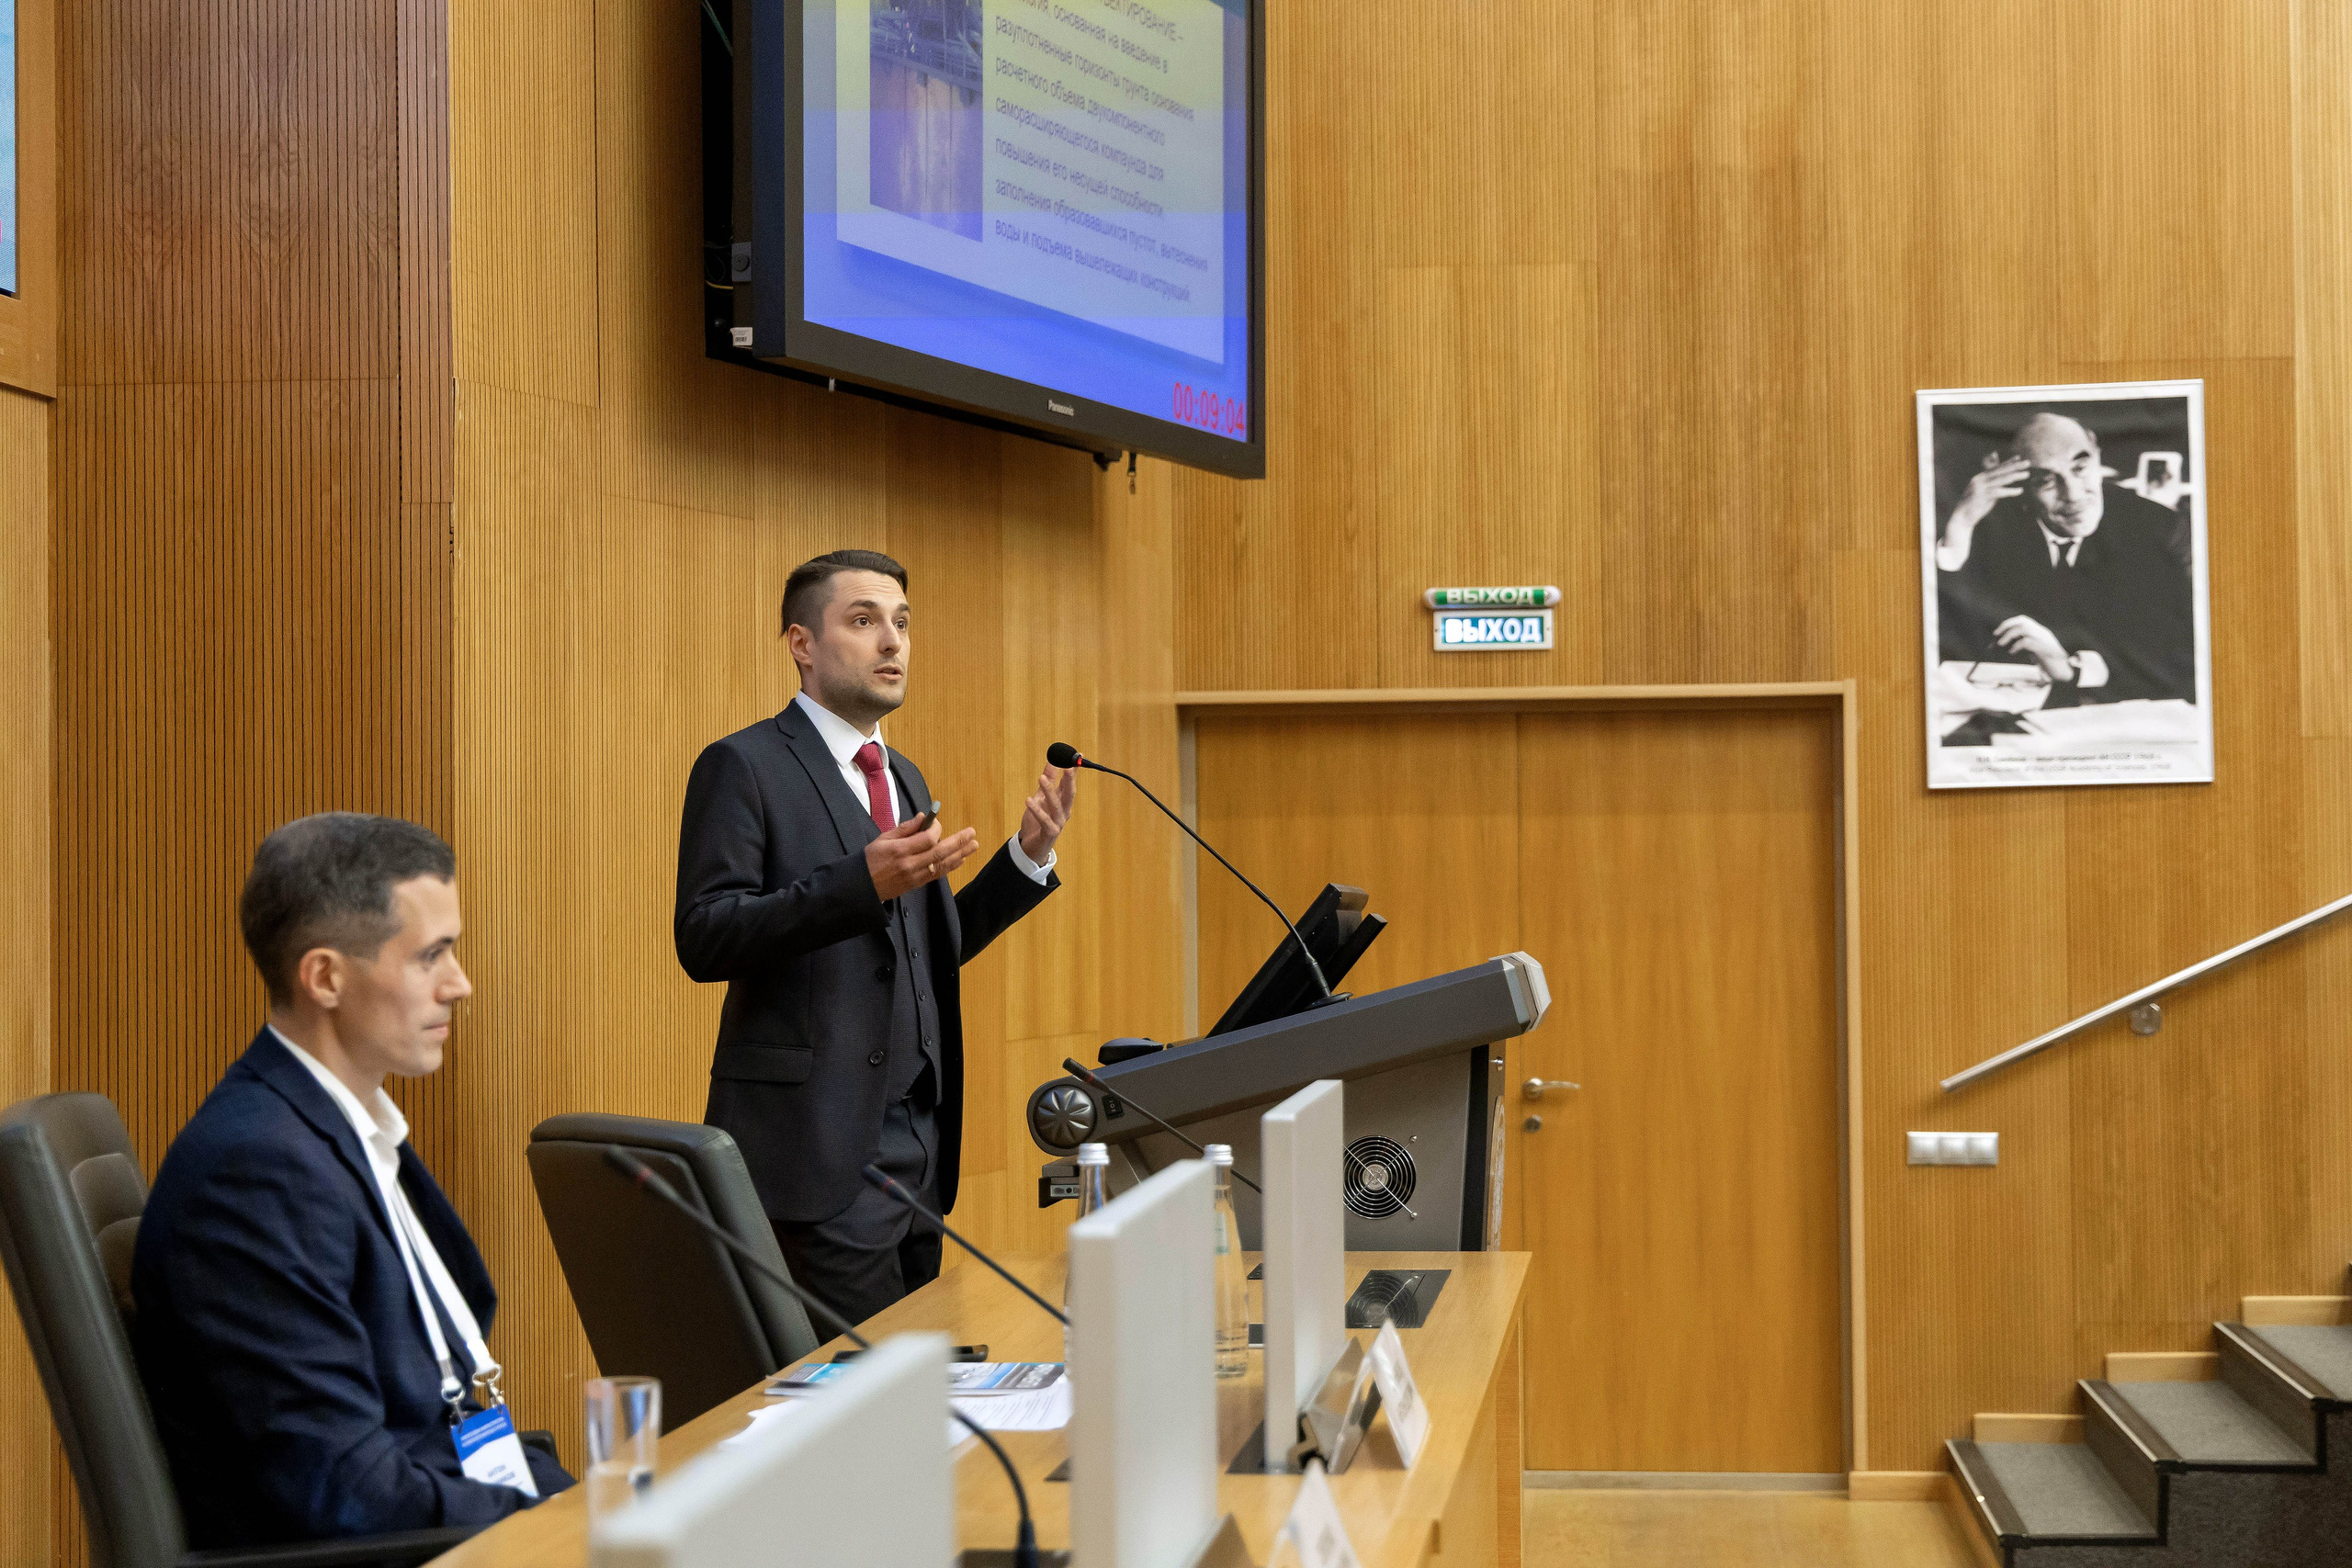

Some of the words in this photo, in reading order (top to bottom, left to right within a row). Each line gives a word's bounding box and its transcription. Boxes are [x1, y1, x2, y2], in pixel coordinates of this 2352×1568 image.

[1053, 5, 1105, 40] основанная
[995, 57, 1047, 93] расчетного
[1050, 80, 1084, 110] объема
[995, 138, 1049, 172] повышения
[1052, 163, 1067, 180] его
[995, 179, 1051, 211] заполнения
[995, 220, 1020, 242] воды
[1023, 230, 1028, 245] и
[1172, 381, 1245, 435] 00:09:04
[1446, 587, 1533, 604] ВЫХОД
[1445, 617, 1543, 643] ВЫХОД
